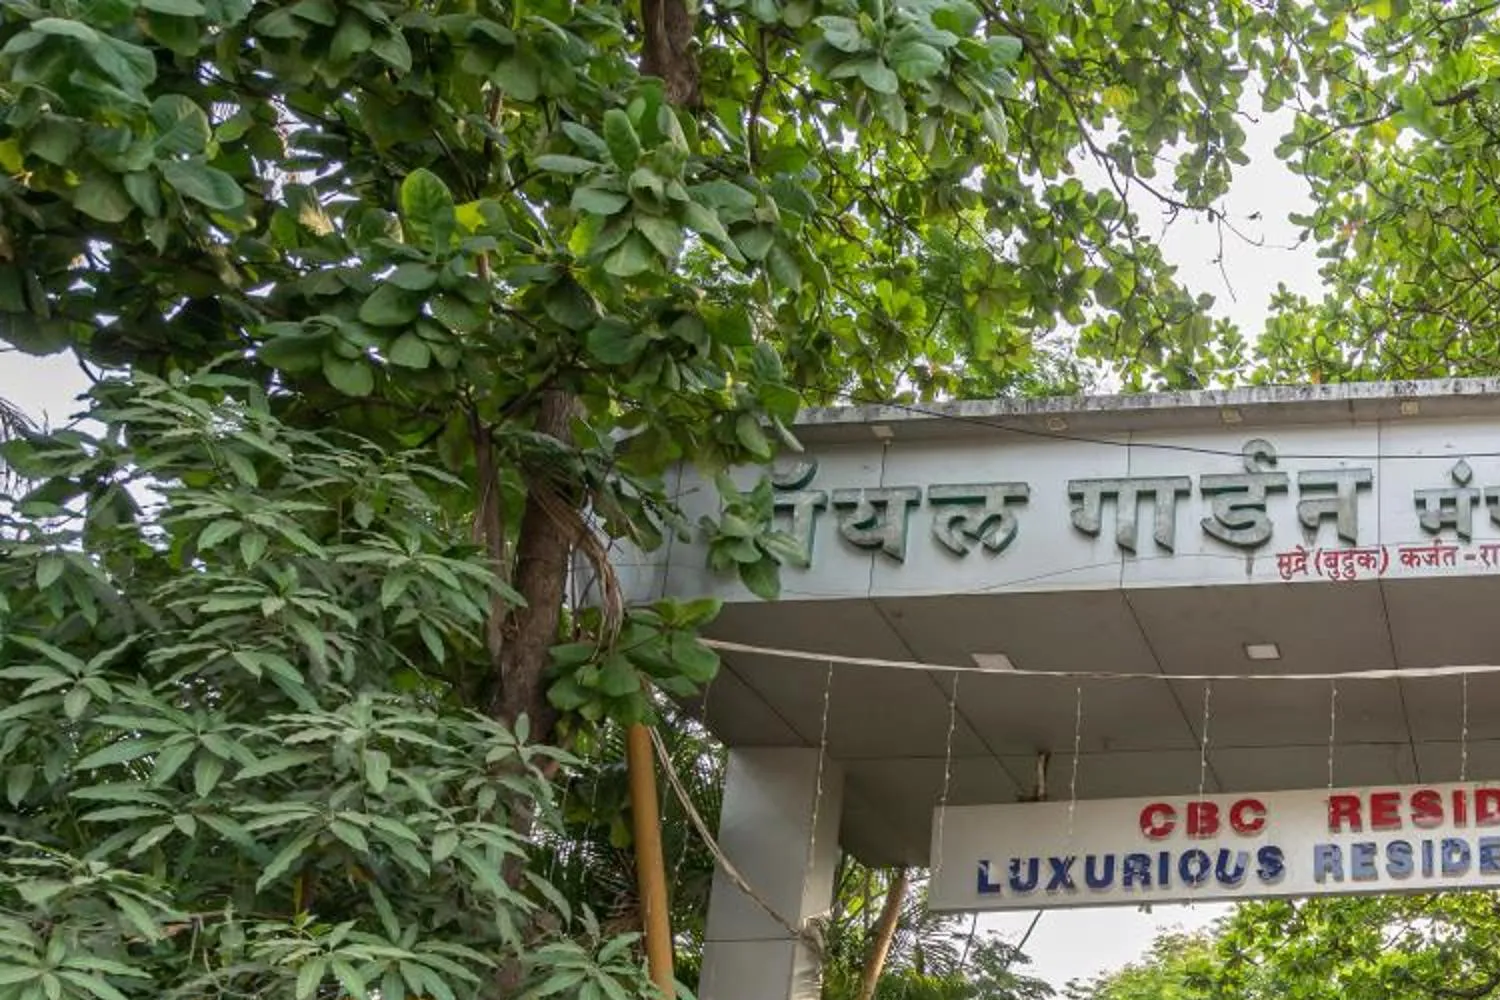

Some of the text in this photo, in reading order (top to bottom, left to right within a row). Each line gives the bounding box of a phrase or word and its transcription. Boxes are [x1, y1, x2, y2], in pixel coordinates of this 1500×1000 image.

[740, 454, 1030, 568] ॉयल
[1068, 438, 1373, 556] गार्डन
[1399, 540, 1459, 567] कर्जत
[1139, 798, 1267, 840] CBC
[977, 845, 1286, 895] LUXURIOUS
